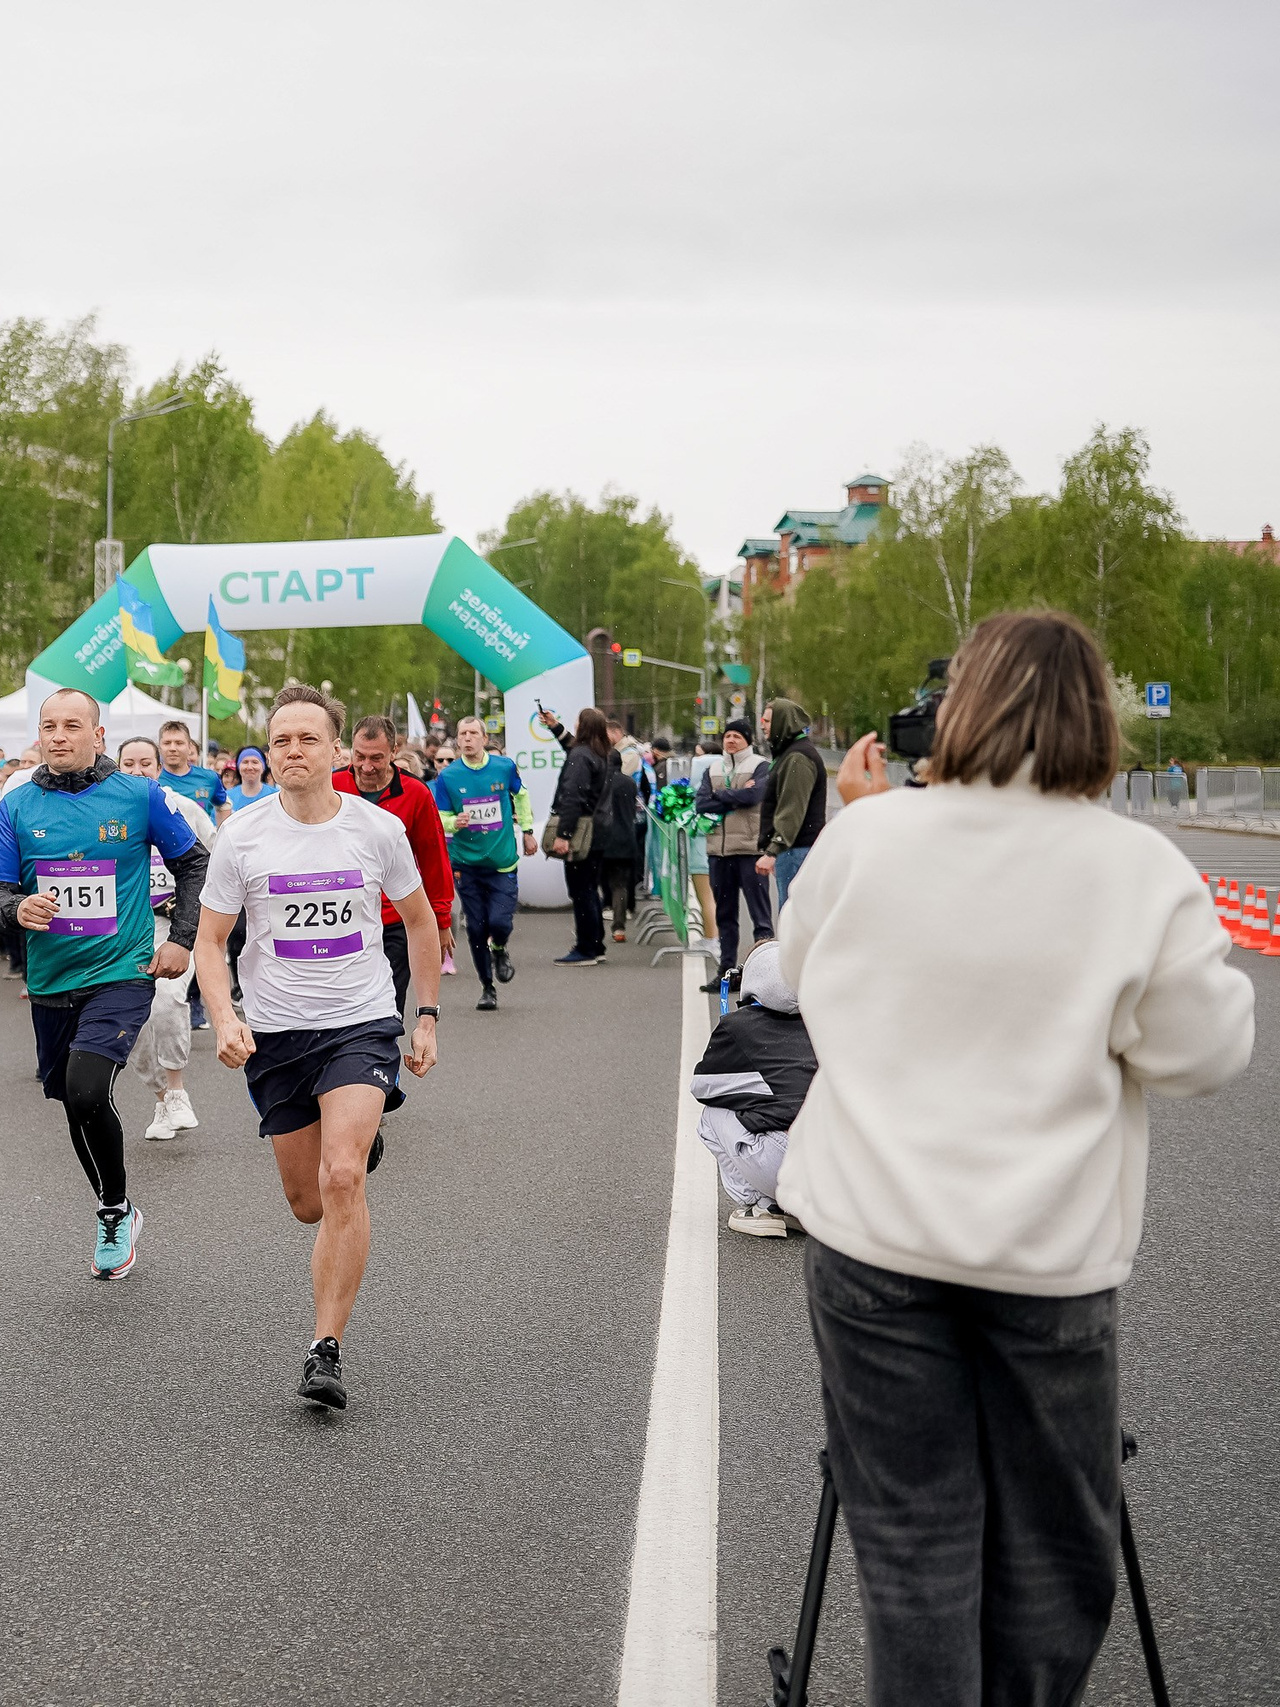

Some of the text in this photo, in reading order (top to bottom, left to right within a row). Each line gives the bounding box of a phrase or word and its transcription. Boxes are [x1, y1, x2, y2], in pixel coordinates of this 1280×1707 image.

[219, 567, 375, 605] СТАРТ
[448, 600, 517, 662] марафон
[460, 588, 531, 650] зелёный
[84, 630, 123, 675] мара
[1152, 684, 1166, 706] P
[515, 750, 565, 769] СБЕ
[48, 885, 104, 908] 2151
[284, 900, 353, 928] 2256
